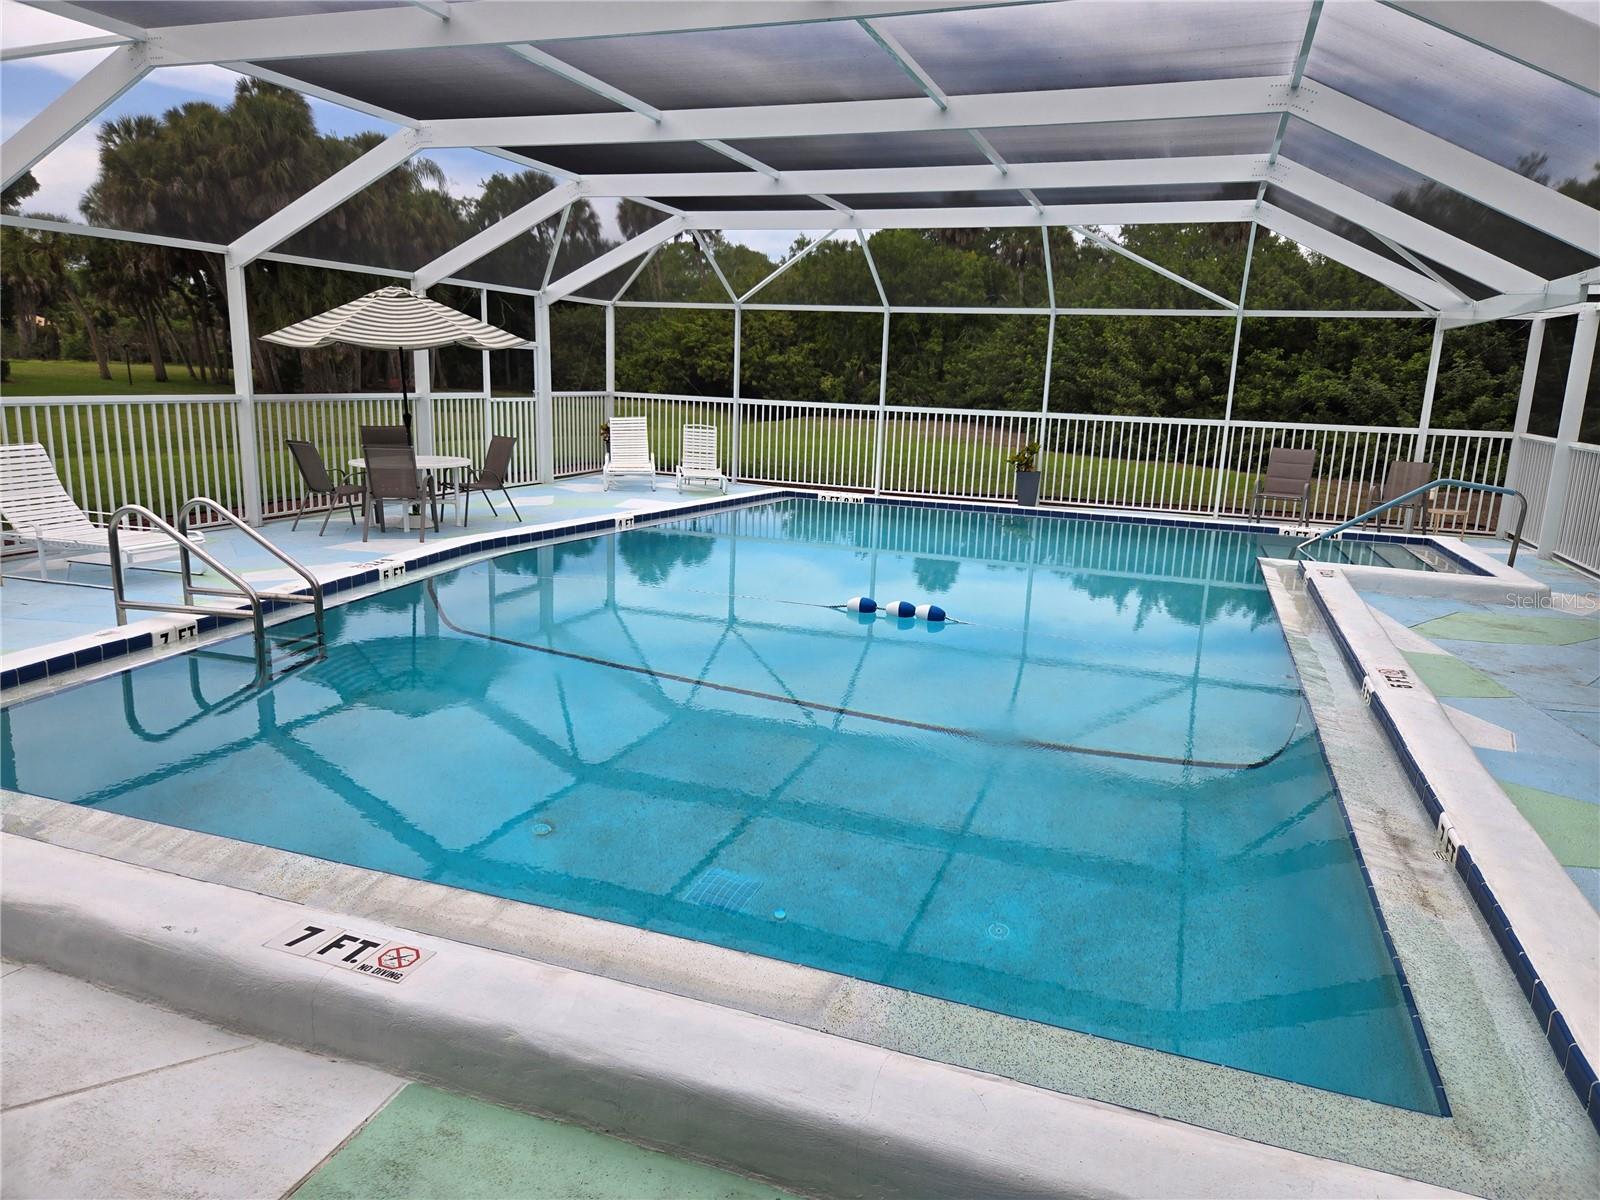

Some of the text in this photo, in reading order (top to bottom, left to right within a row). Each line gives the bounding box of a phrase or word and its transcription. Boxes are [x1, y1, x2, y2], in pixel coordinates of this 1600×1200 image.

[160, 625, 196, 644] 7 FT
[1445, 836, 1457, 863] FT
[284, 925, 326, 947] 7
[357, 963, 404, 981] NO DIVING
